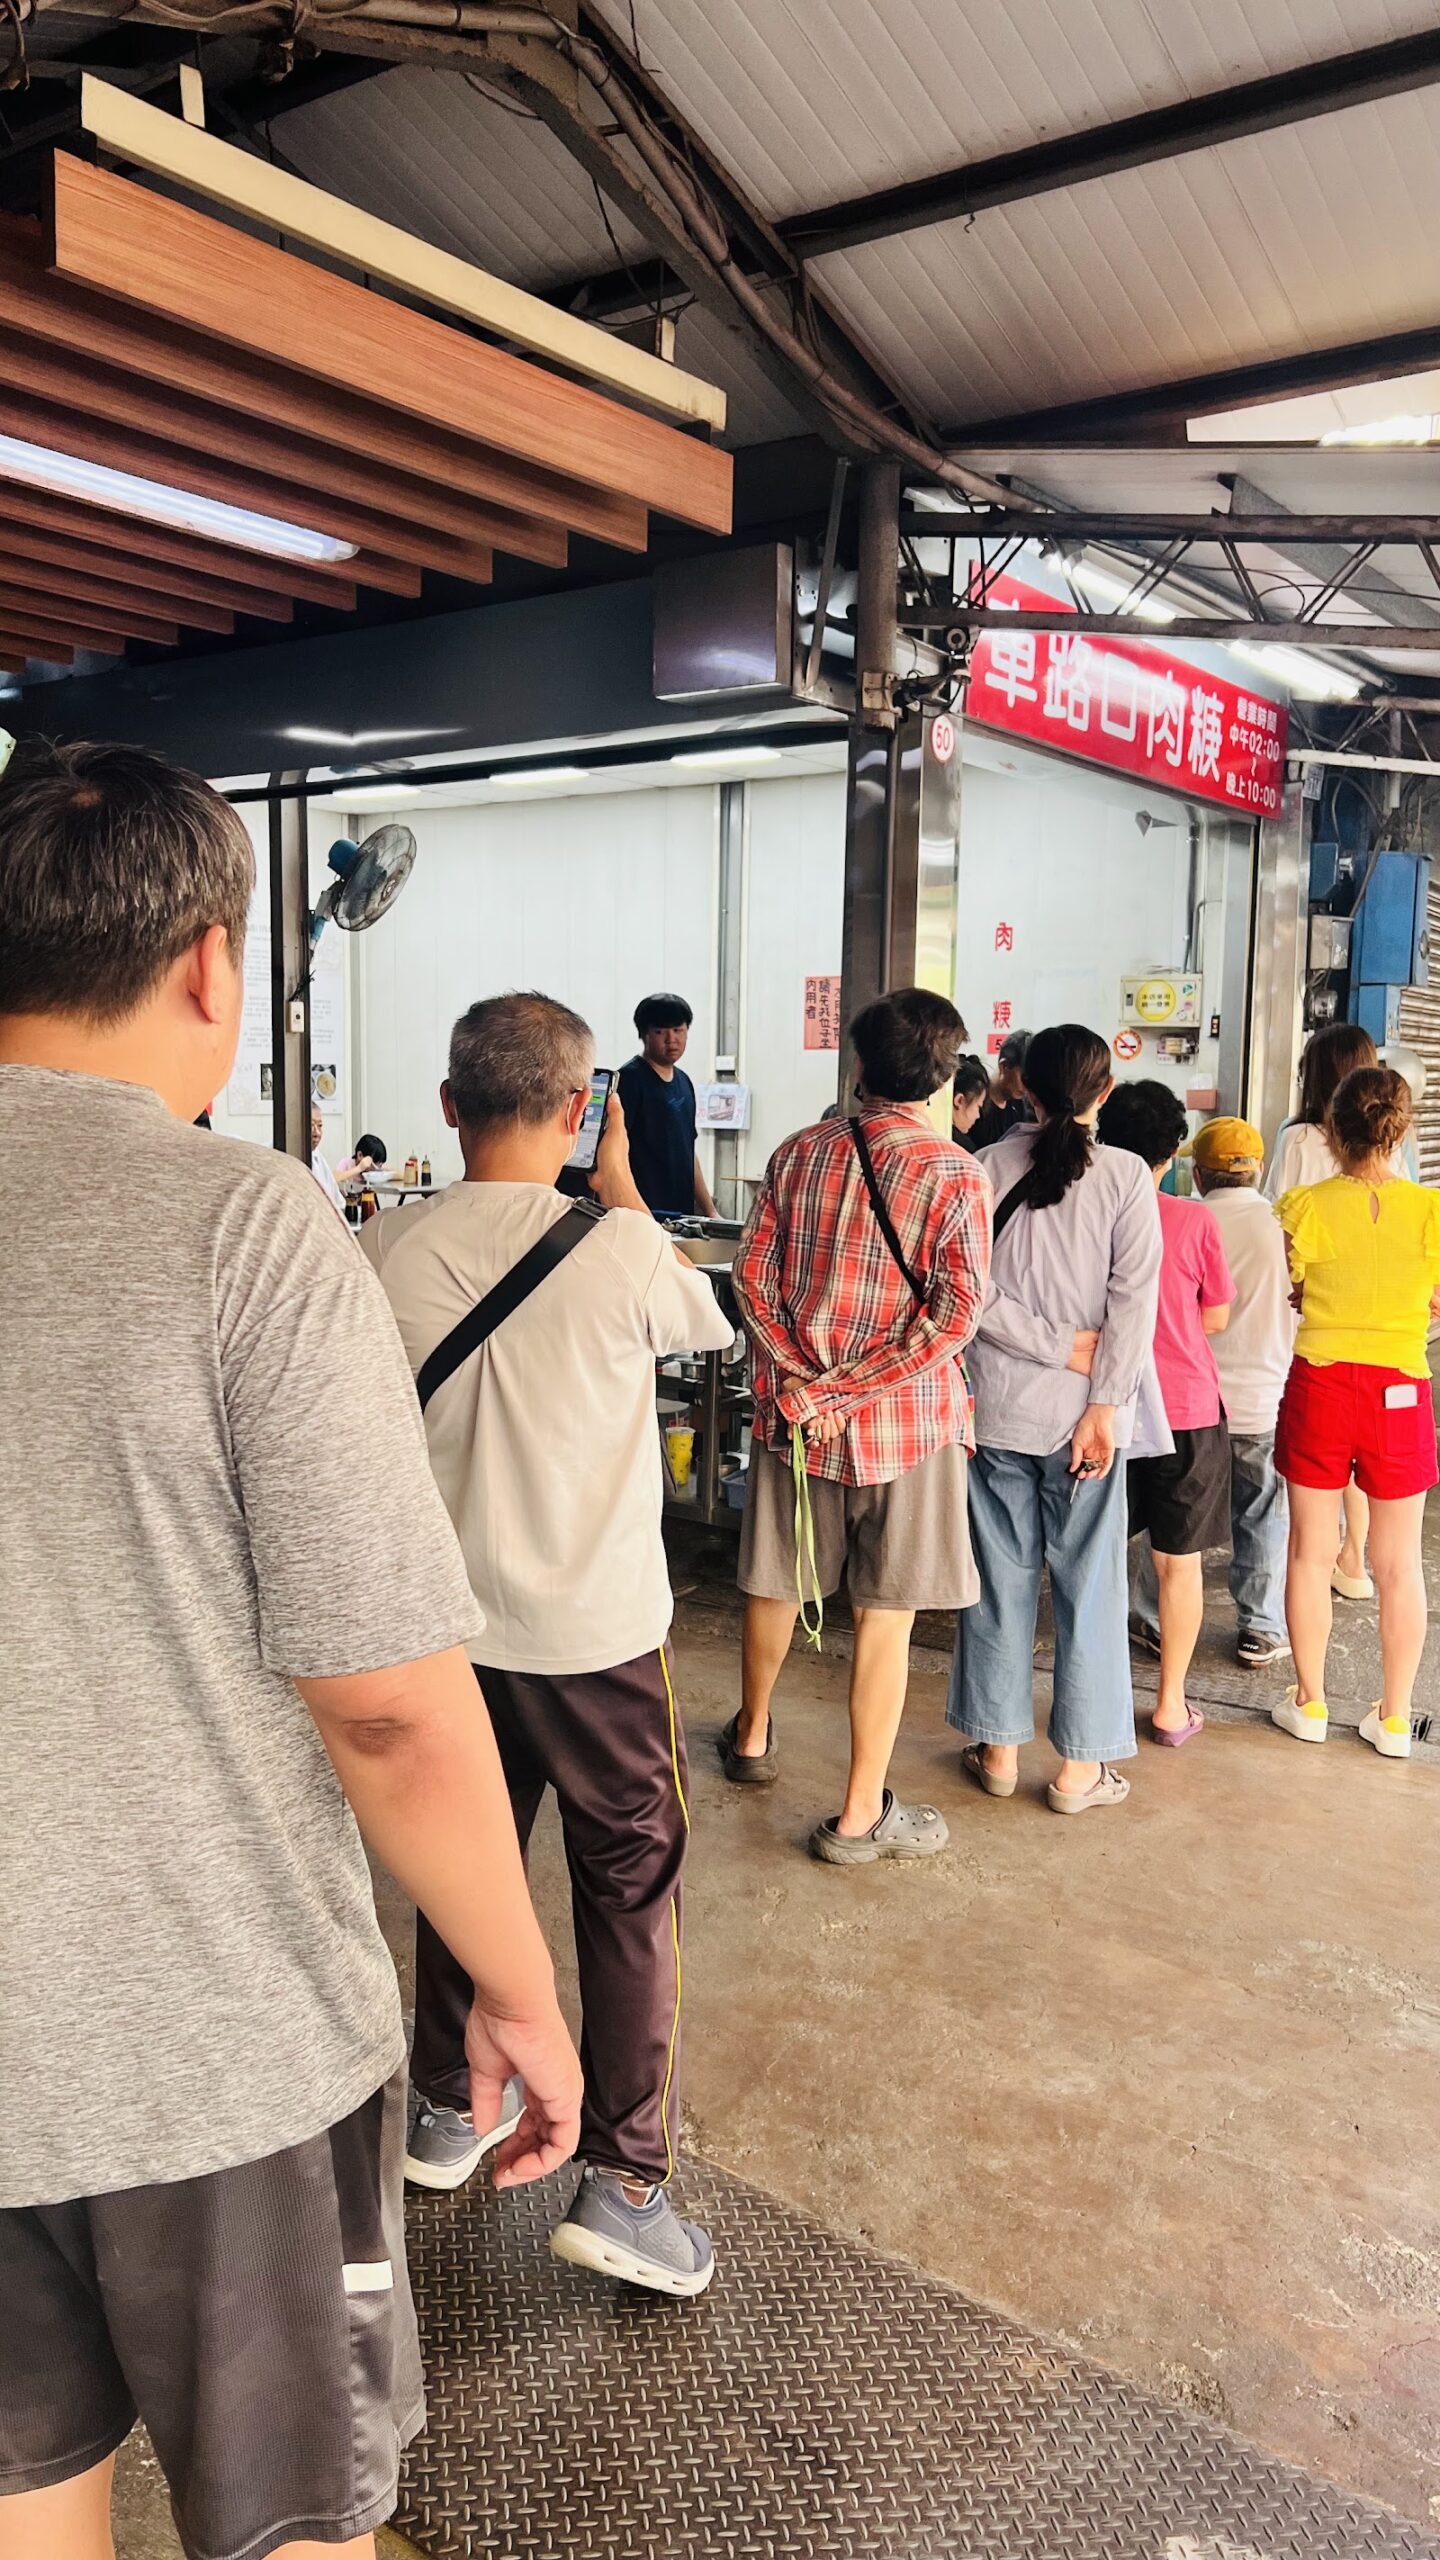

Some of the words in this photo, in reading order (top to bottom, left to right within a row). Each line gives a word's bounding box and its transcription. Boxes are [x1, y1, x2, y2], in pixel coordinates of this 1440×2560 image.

[1236, 695, 1278, 734] 營業時間
[936, 724, 950, 753] 50
[1229, 723, 1281, 763] 中午02:00
[1225, 771, 1277, 809] 晚上10:00
